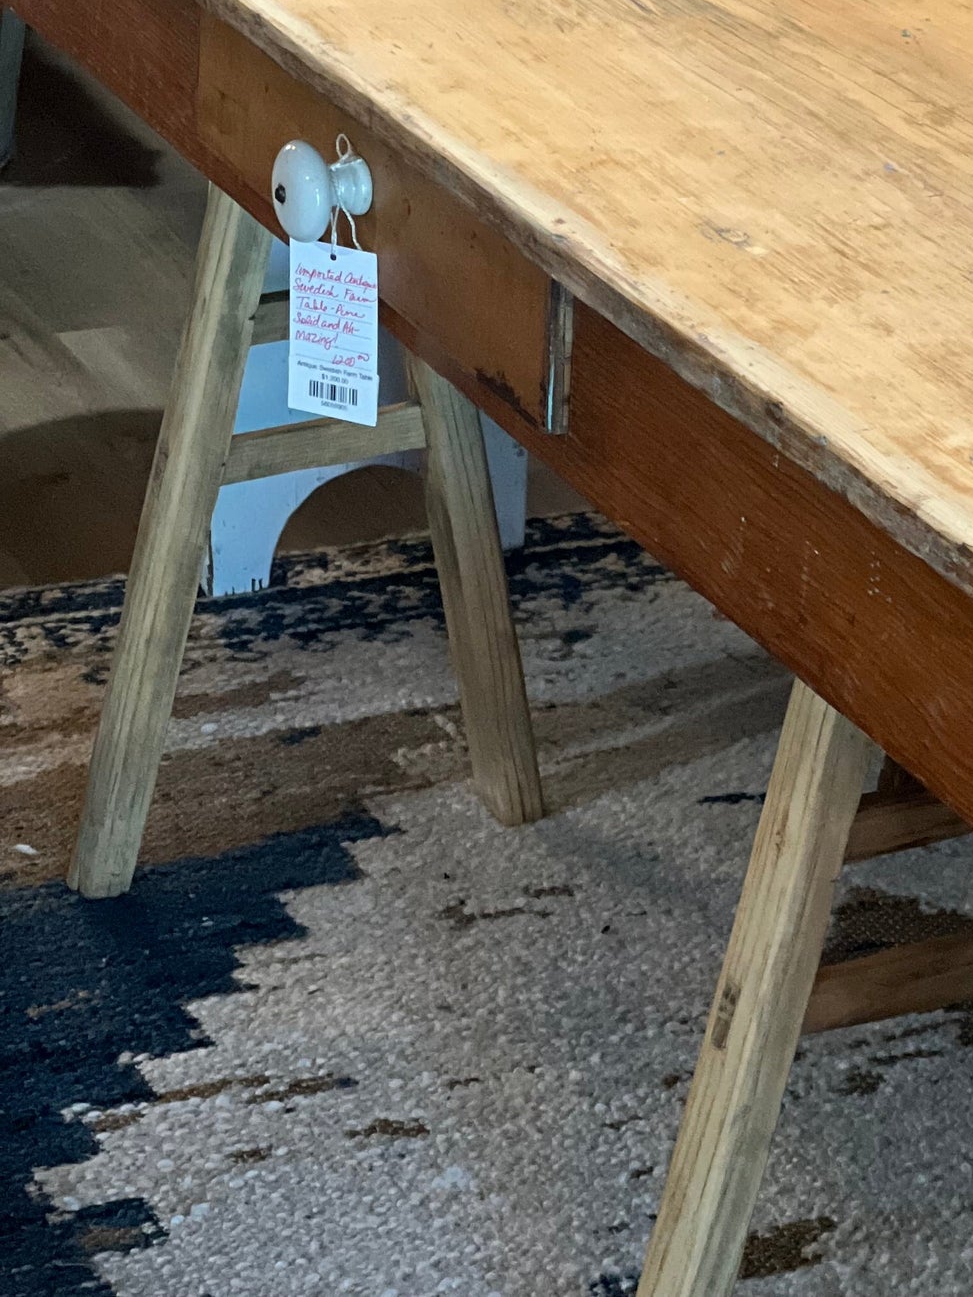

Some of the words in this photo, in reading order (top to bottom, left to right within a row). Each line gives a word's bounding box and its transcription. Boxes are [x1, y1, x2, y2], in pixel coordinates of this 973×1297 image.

[295, 262, 343, 284] Imported
[293, 278, 339, 298] Swedish
[343, 287, 377, 303] Farm
[296, 296, 328, 312] Table
[293, 311, 321, 327] Solid
[320, 317, 341, 330] and
[297, 360, 318, 370] Antique
[319, 364, 342, 375] Swedish
[343, 370, 358, 378] Farm
[359, 372, 373, 381] Table
